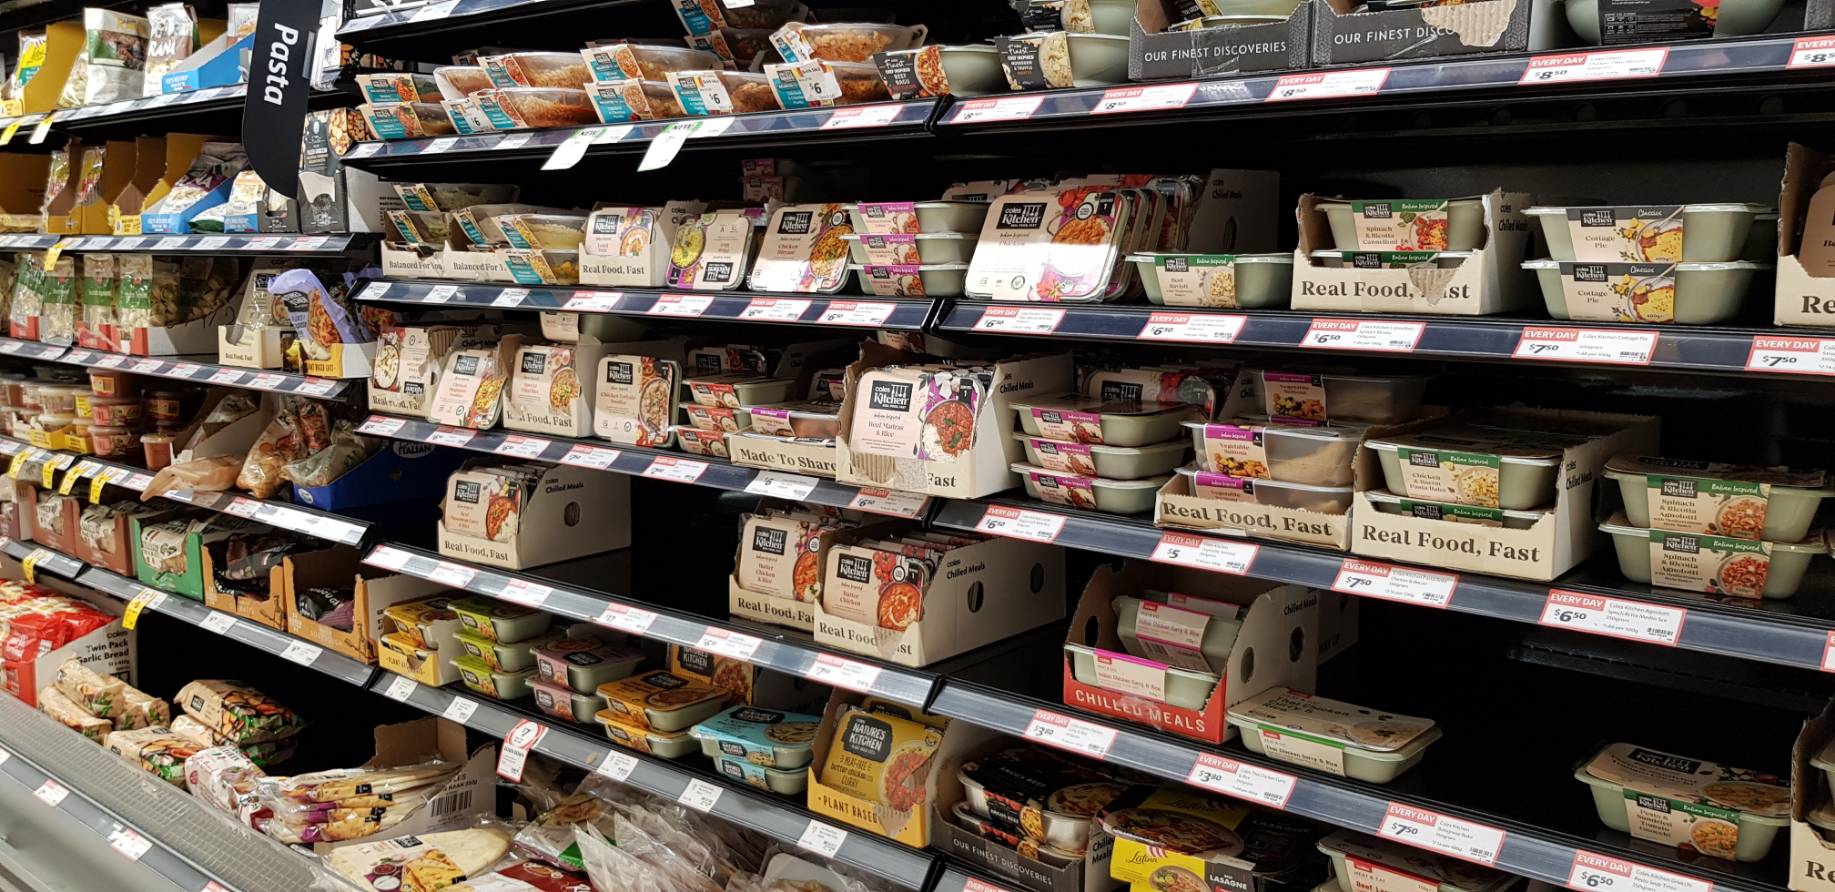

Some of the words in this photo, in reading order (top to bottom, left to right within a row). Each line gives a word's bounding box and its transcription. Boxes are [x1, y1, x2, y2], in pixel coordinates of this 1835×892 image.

[1334, 33, 1361, 45] OUR
[1367, 28, 1410, 41] FINEST
[1144, 51, 1168, 62] OUR
[1171, 47, 1209, 60] FINEST
[1214, 40, 1286, 57] DISCOVERIES
[264, 23, 298, 106] Pasta
[1531, 57, 1560, 66] EVERY
[1561, 55, 1585, 65] DAY
[1279, 77, 1303, 85] EVERY
[1304, 75, 1323, 84] DAY
[1364, 209, 1391, 219] Kitchen
[1637, 208, 1663, 218] Classics
[782, 219, 809, 231] Kitchen
[1002, 213, 1040, 226] Kitchen
[1583, 216, 1612, 225] Kitchen
[1585, 234, 1615, 243] Cottage
[583, 263, 600, 274] Real
[602, 263, 625, 276] Food,
[626, 265, 645, 275] Fast
[1576, 270, 1605, 280] Kitchen
[1630, 265, 1656, 275] Classics
[1302, 280, 1347, 298] Real
[1354, 281, 1414, 299] Food,
[1577, 289, 1608, 298] Cottage
[1586, 296, 1600, 304] Pie
[1312, 323, 1336, 332] EVERY
[1337, 324, 1357, 333] DAY
[1525, 330, 1553, 340] EVERY
[1555, 331, 1577, 341] DAY
[1756, 339, 1789, 350] EVERY
[1790, 341, 1817, 350] DAY
[1000, 381, 1019, 393] Chilled
[873, 391, 910, 406] Kitchen
[553, 415, 573, 428] Fast
[868, 421, 881, 429] Beef
[882, 422, 904, 431] Madras
[882, 430, 894, 438] Rice
[398, 444, 432, 455] ITALIAN
[740, 447, 774, 464] Made
[777, 452, 796, 465] To
[1410, 456, 1438, 467] Kitchen
[927, 472, 957, 489] Fast
[1411, 471, 1441, 481] Chicken
[545, 484, 566, 494] Chilled
[567, 482, 584, 491] Meals
[1663, 485, 1695, 495] Kitchen
[1711, 483, 1732, 492] Italian
[1732, 485, 1759, 496] Inspired
[1661, 499, 1696, 509] Spinach
[1659, 512, 1698, 521] Agnolotti
[1666, 507, 1697, 515] Ricotta
[1161, 501, 1210, 521] Real
[1216, 508, 1278, 532] Food,
[1281, 516, 1333, 537] Fast
[755, 535, 784, 550] Kitchen
[1362, 524, 1411, 546] Real
[1417, 531, 1482, 557] Food,
[1488, 540, 1541, 564] Fast
[1666, 541, 1698, 552] Kitchen
[1713, 540, 1734, 549] Italian
[1735, 542, 1760, 553] Inspired
[445, 540, 463, 553] Real
[464, 543, 489, 560] Food,
[490, 548, 509, 561] Fast
[1167, 548, 1180, 559] $5
[1663, 554, 1697, 564] Spinach
[840, 562, 869, 578] Kitchen
[1344, 562, 1368, 573] EVERY
[1369, 565, 1389, 576] DAY
[1669, 561, 1699, 570] Ricotta
[946, 568, 968, 581] Chilled
[968, 563, 985, 576] Meals
[1661, 567, 1700, 577] Agnolotti
[1551, 593, 1581, 605] EVERY
[1582, 598, 1604, 610] DAY
[737, 597, 762, 613] Real
[764, 603, 796, 622] Food,
[819, 622, 846, 639] Real
[109, 639, 129, 650] Pack
[104, 649, 129, 661] Bread
[683, 652, 708, 667] KITCHEN
[1075, 689, 1144, 717] CHILLED
[1149, 709, 1206, 732] MEALS
[853, 722, 886, 740] NATURES
[849, 733, 883, 752] KITCHEN
[1221, 760, 1238, 772] DAY
[823, 795, 849, 814] PLANT
[1390, 805, 1416, 819] EVERY
[1416, 811, 1436, 824] DAY
[953, 837, 970, 850] OUR
[972, 844, 999, 864] FINEST
[1001, 856, 1053, 886] DISCOVERIES
[1126, 850, 1159, 864] Latina
[1577, 854, 1608, 867] EVERY
[1609, 861, 1630, 874] DAY
[1209, 874, 1247, 890] LASAGNE
